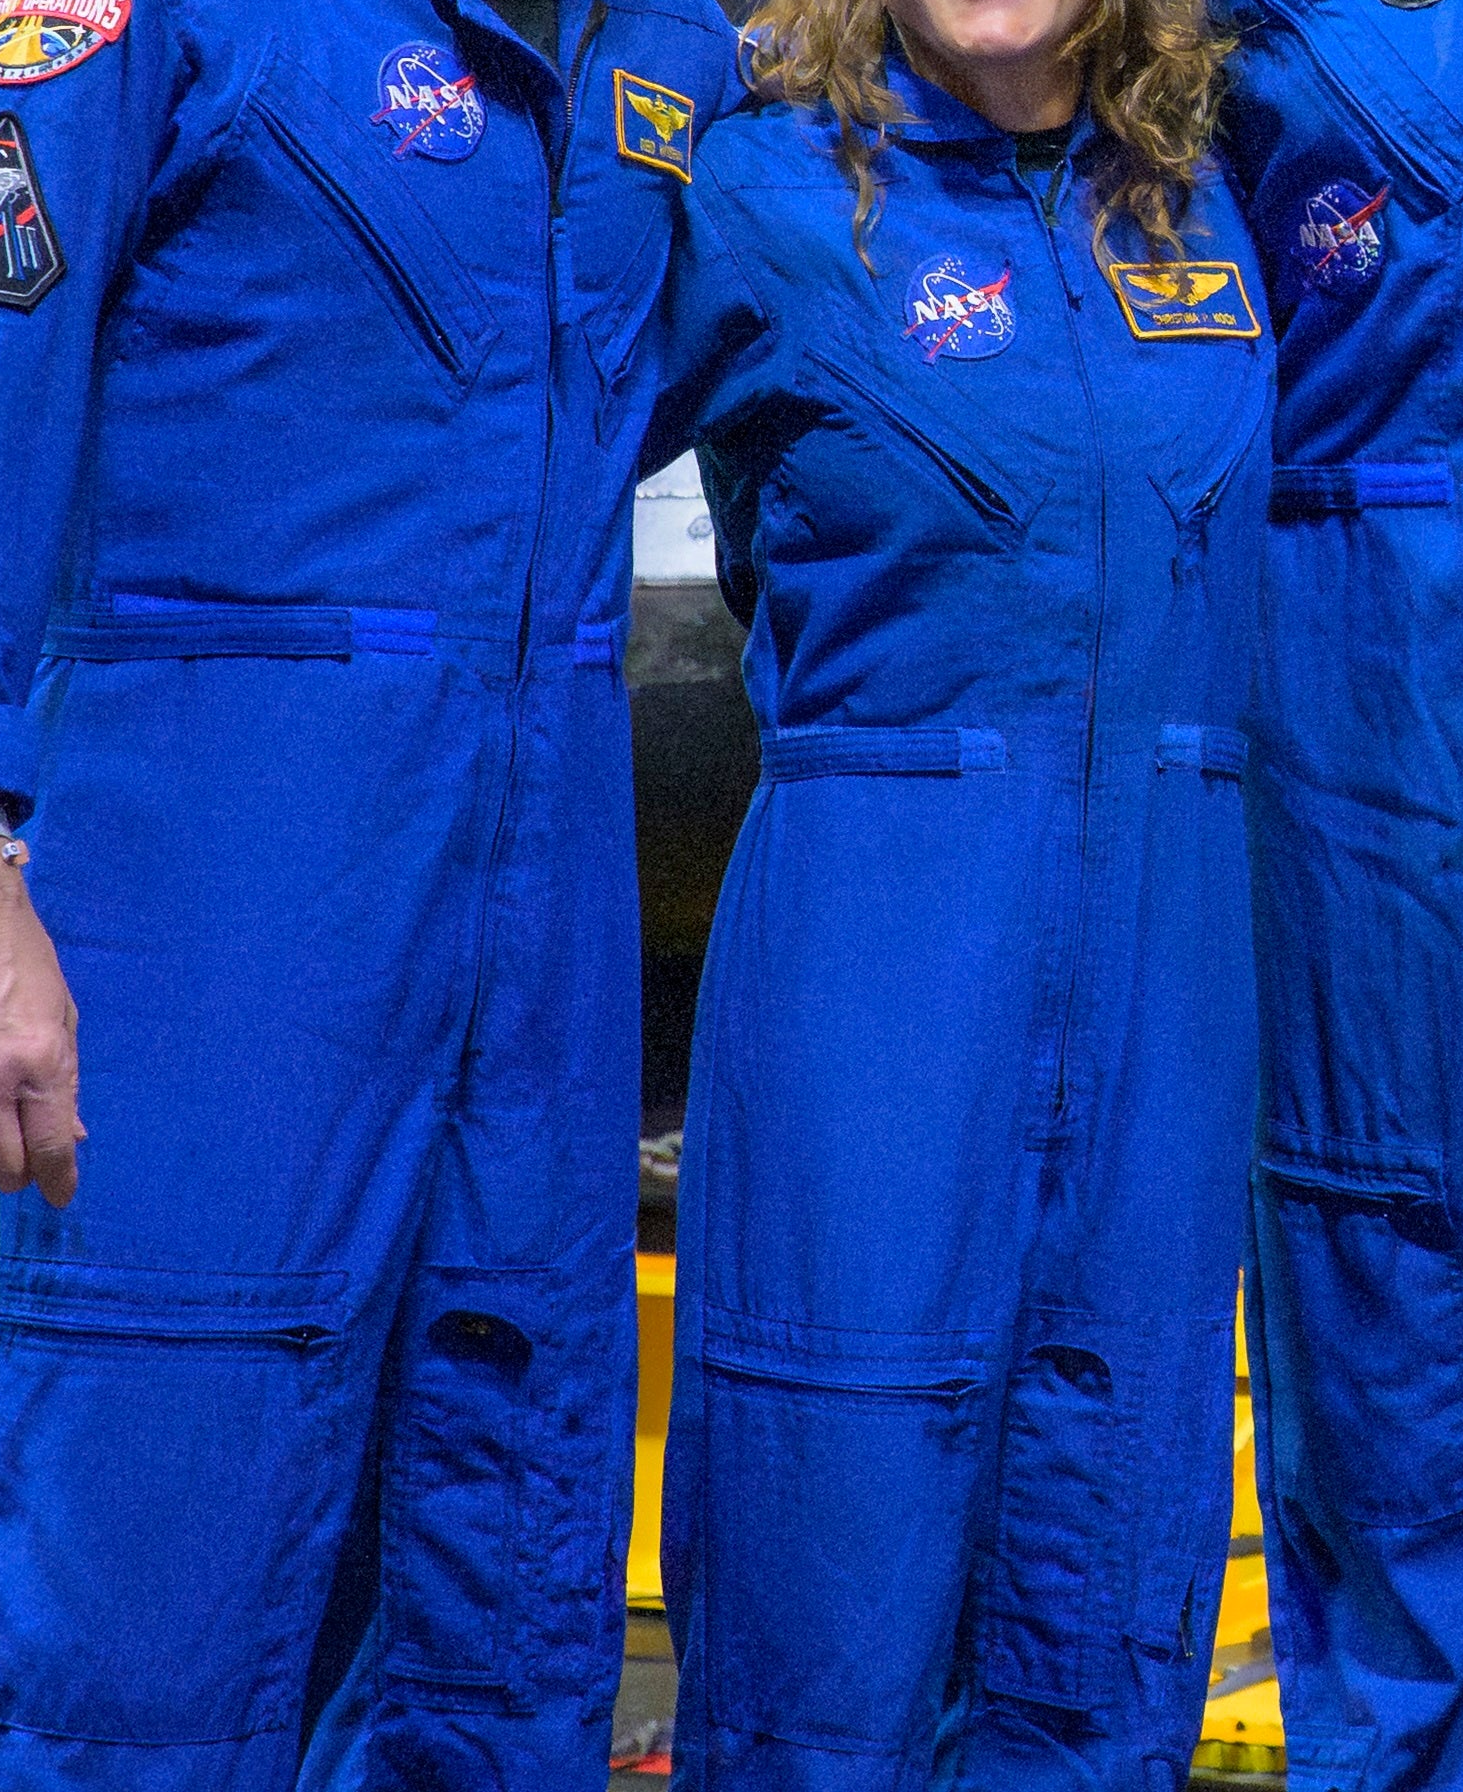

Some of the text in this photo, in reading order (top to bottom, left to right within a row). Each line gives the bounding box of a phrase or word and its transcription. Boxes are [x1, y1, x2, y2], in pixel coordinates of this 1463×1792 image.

[386, 84, 482, 114] NASA
[1299, 221, 1381, 249] NASA
[913, 291, 1011, 324] NASA
